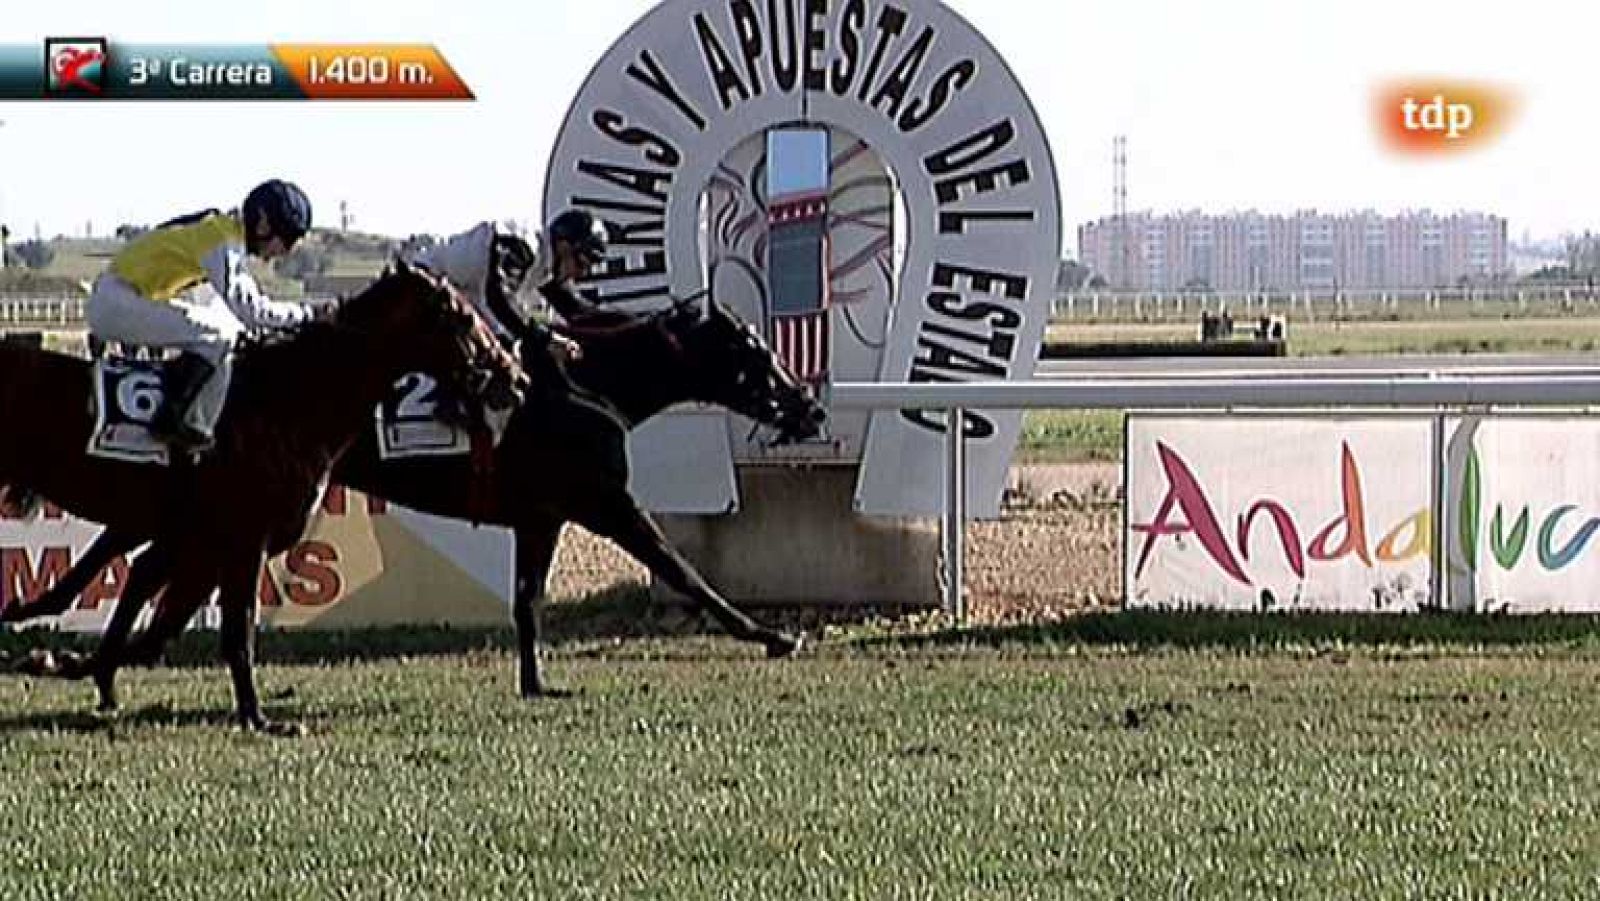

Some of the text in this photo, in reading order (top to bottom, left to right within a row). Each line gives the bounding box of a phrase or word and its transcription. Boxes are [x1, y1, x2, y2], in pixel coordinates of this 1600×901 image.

[624, 49, 707, 130] Y
[693, 0, 975, 132] APUESTAS
[924, 117, 1035, 235] DEL
[116, 372, 164, 422] 6
[394, 372, 438, 419] 2
[898, 261, 1029, 438] ESTAO
